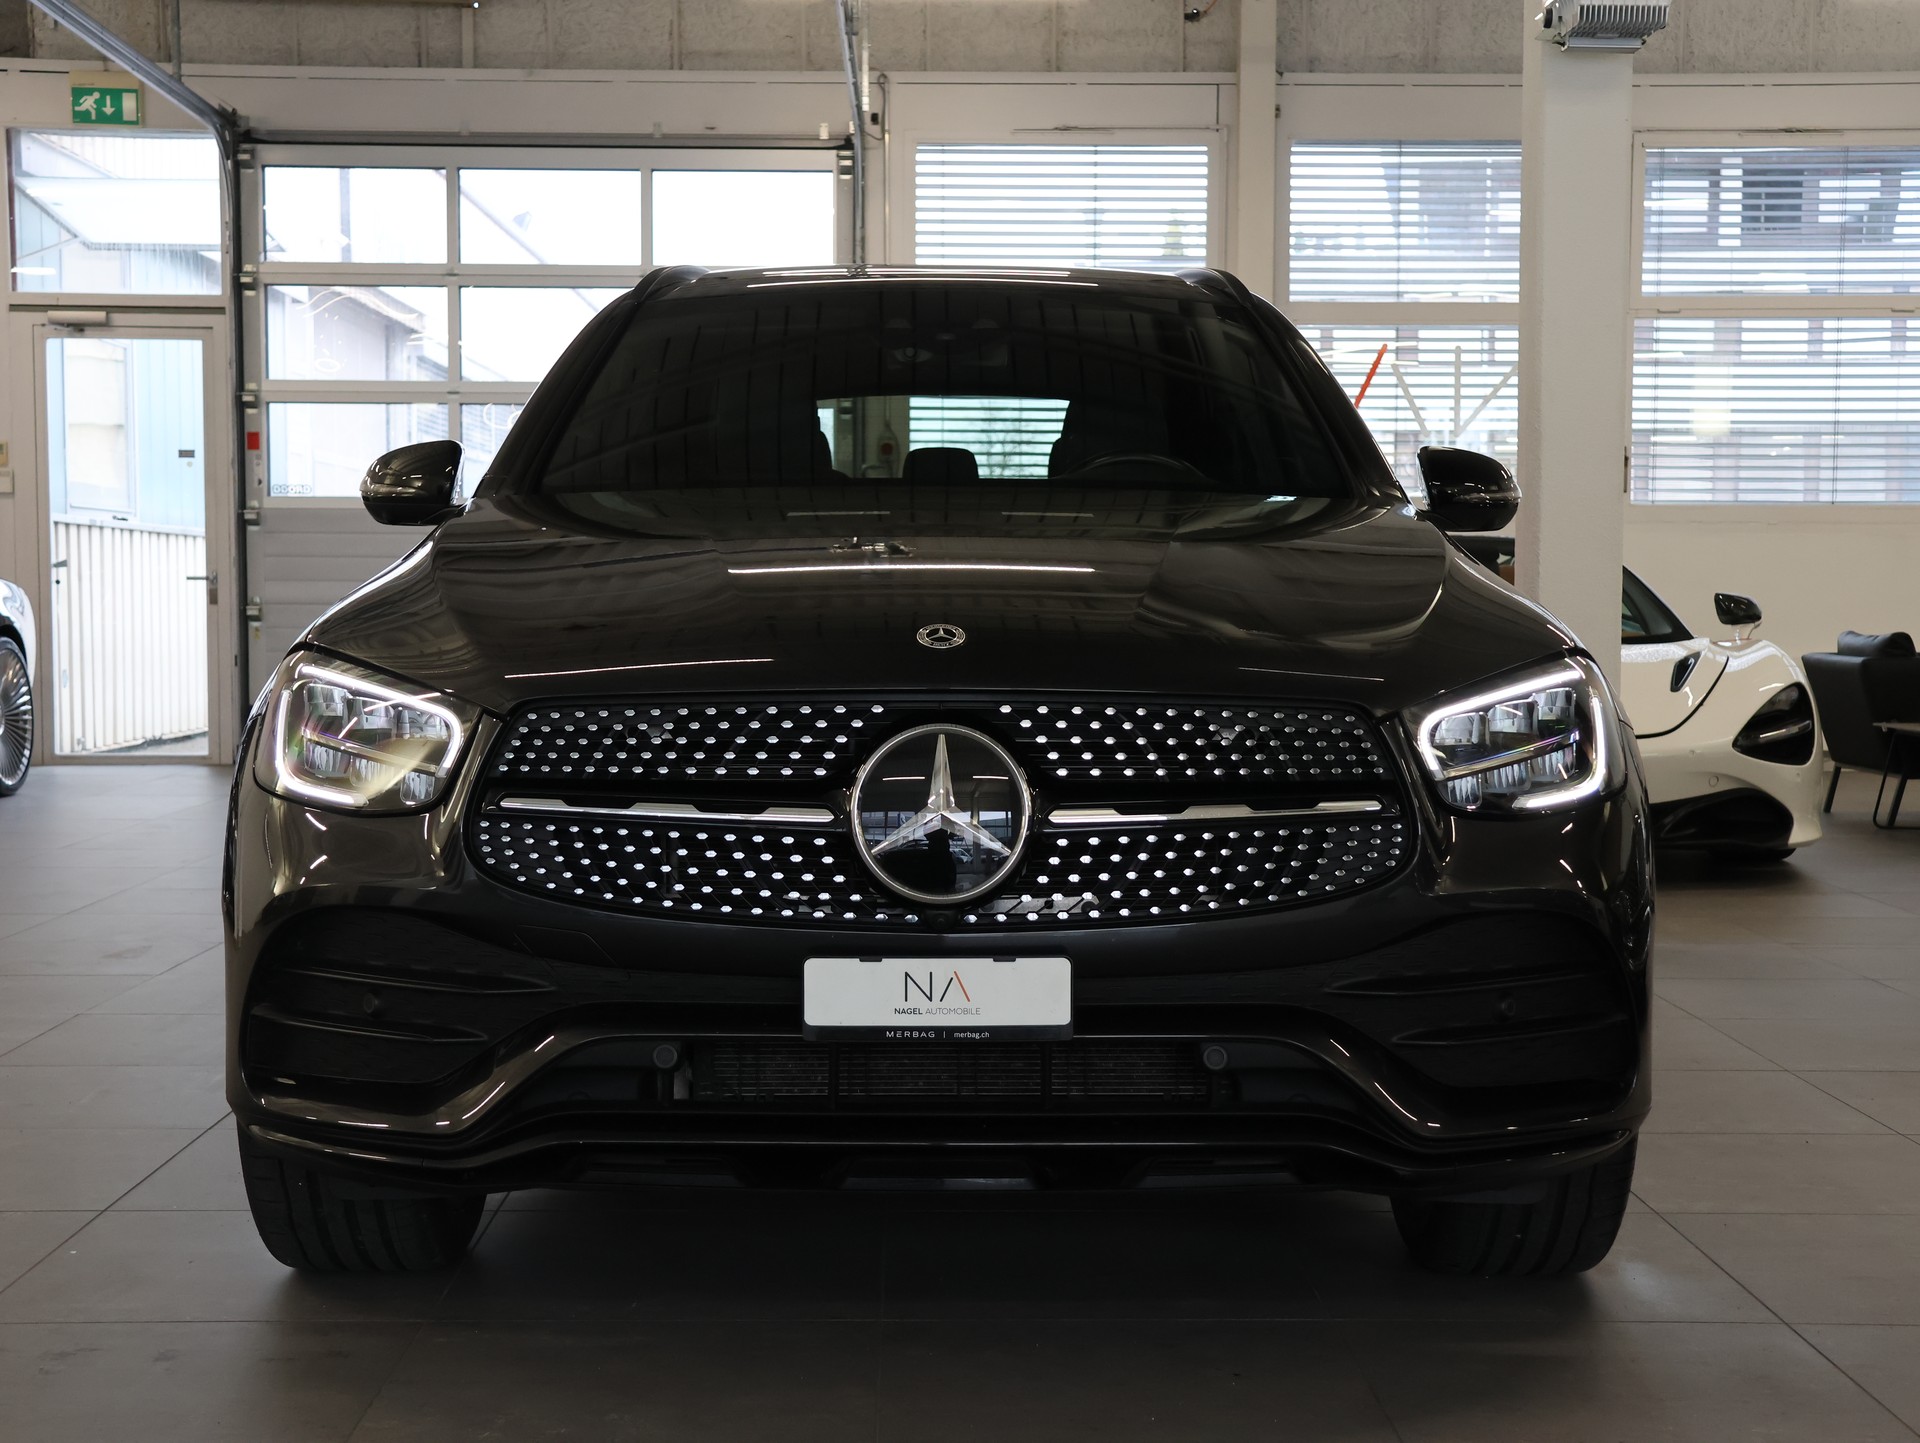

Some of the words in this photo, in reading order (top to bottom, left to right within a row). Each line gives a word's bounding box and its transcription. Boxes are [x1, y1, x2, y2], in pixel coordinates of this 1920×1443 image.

[894, 1007, 923, 1015] NAGEL
[925, 1007, 981, 1015] AUTOMOBILE
[886, 1030, 935, 1038] MERBAG
[953, 1030, 990, 1040] merbag.ch
